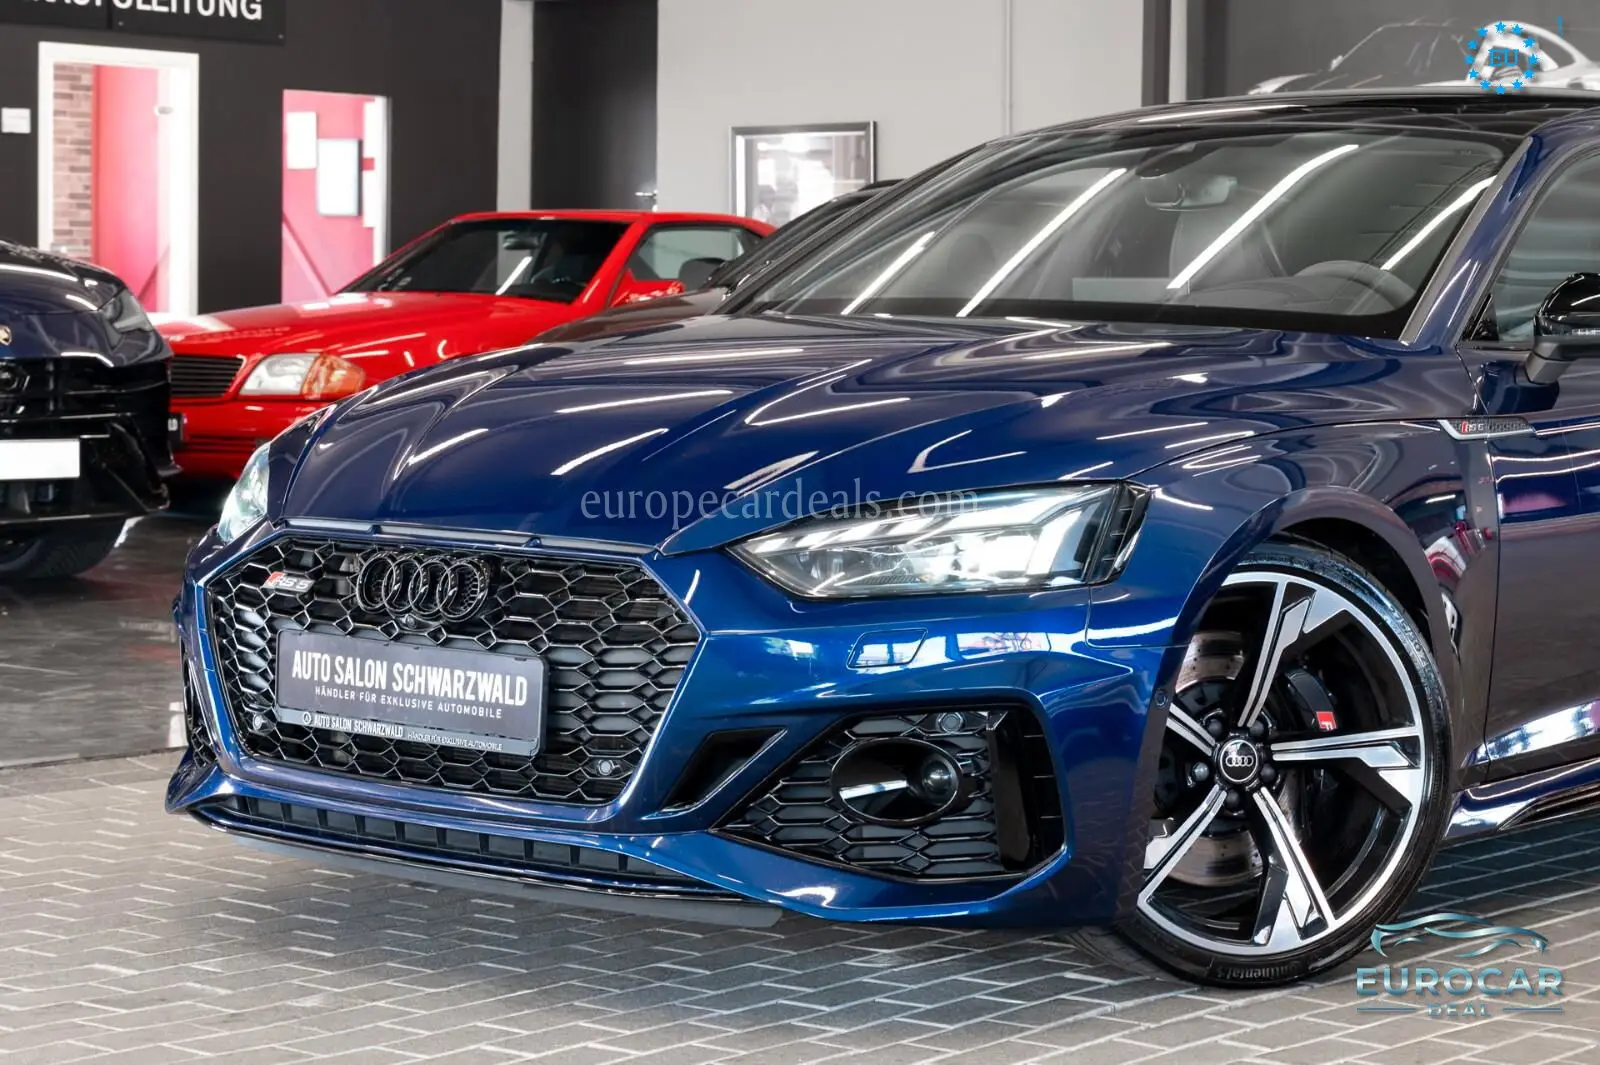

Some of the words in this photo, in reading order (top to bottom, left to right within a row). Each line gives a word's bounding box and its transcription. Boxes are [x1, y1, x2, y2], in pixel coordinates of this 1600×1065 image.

[292, 650, 331, 683] AUTO
[334, 655, 388, 690] SALON
[392, 662, 528, 707] SCHWARZWALD
[315, 685, 356, 701] HÄNDLER
[359, 691, 377, 704] FÜR
[380, 695, 433, 711] EXKLUSIVE
[437, 702, 503, 719] AUTOMOBILE
[314, 714, 331, 728] AUTO
[331, 716, 352, 732] SALON
[354, 718, 404, 738] SCHWARZWALD
